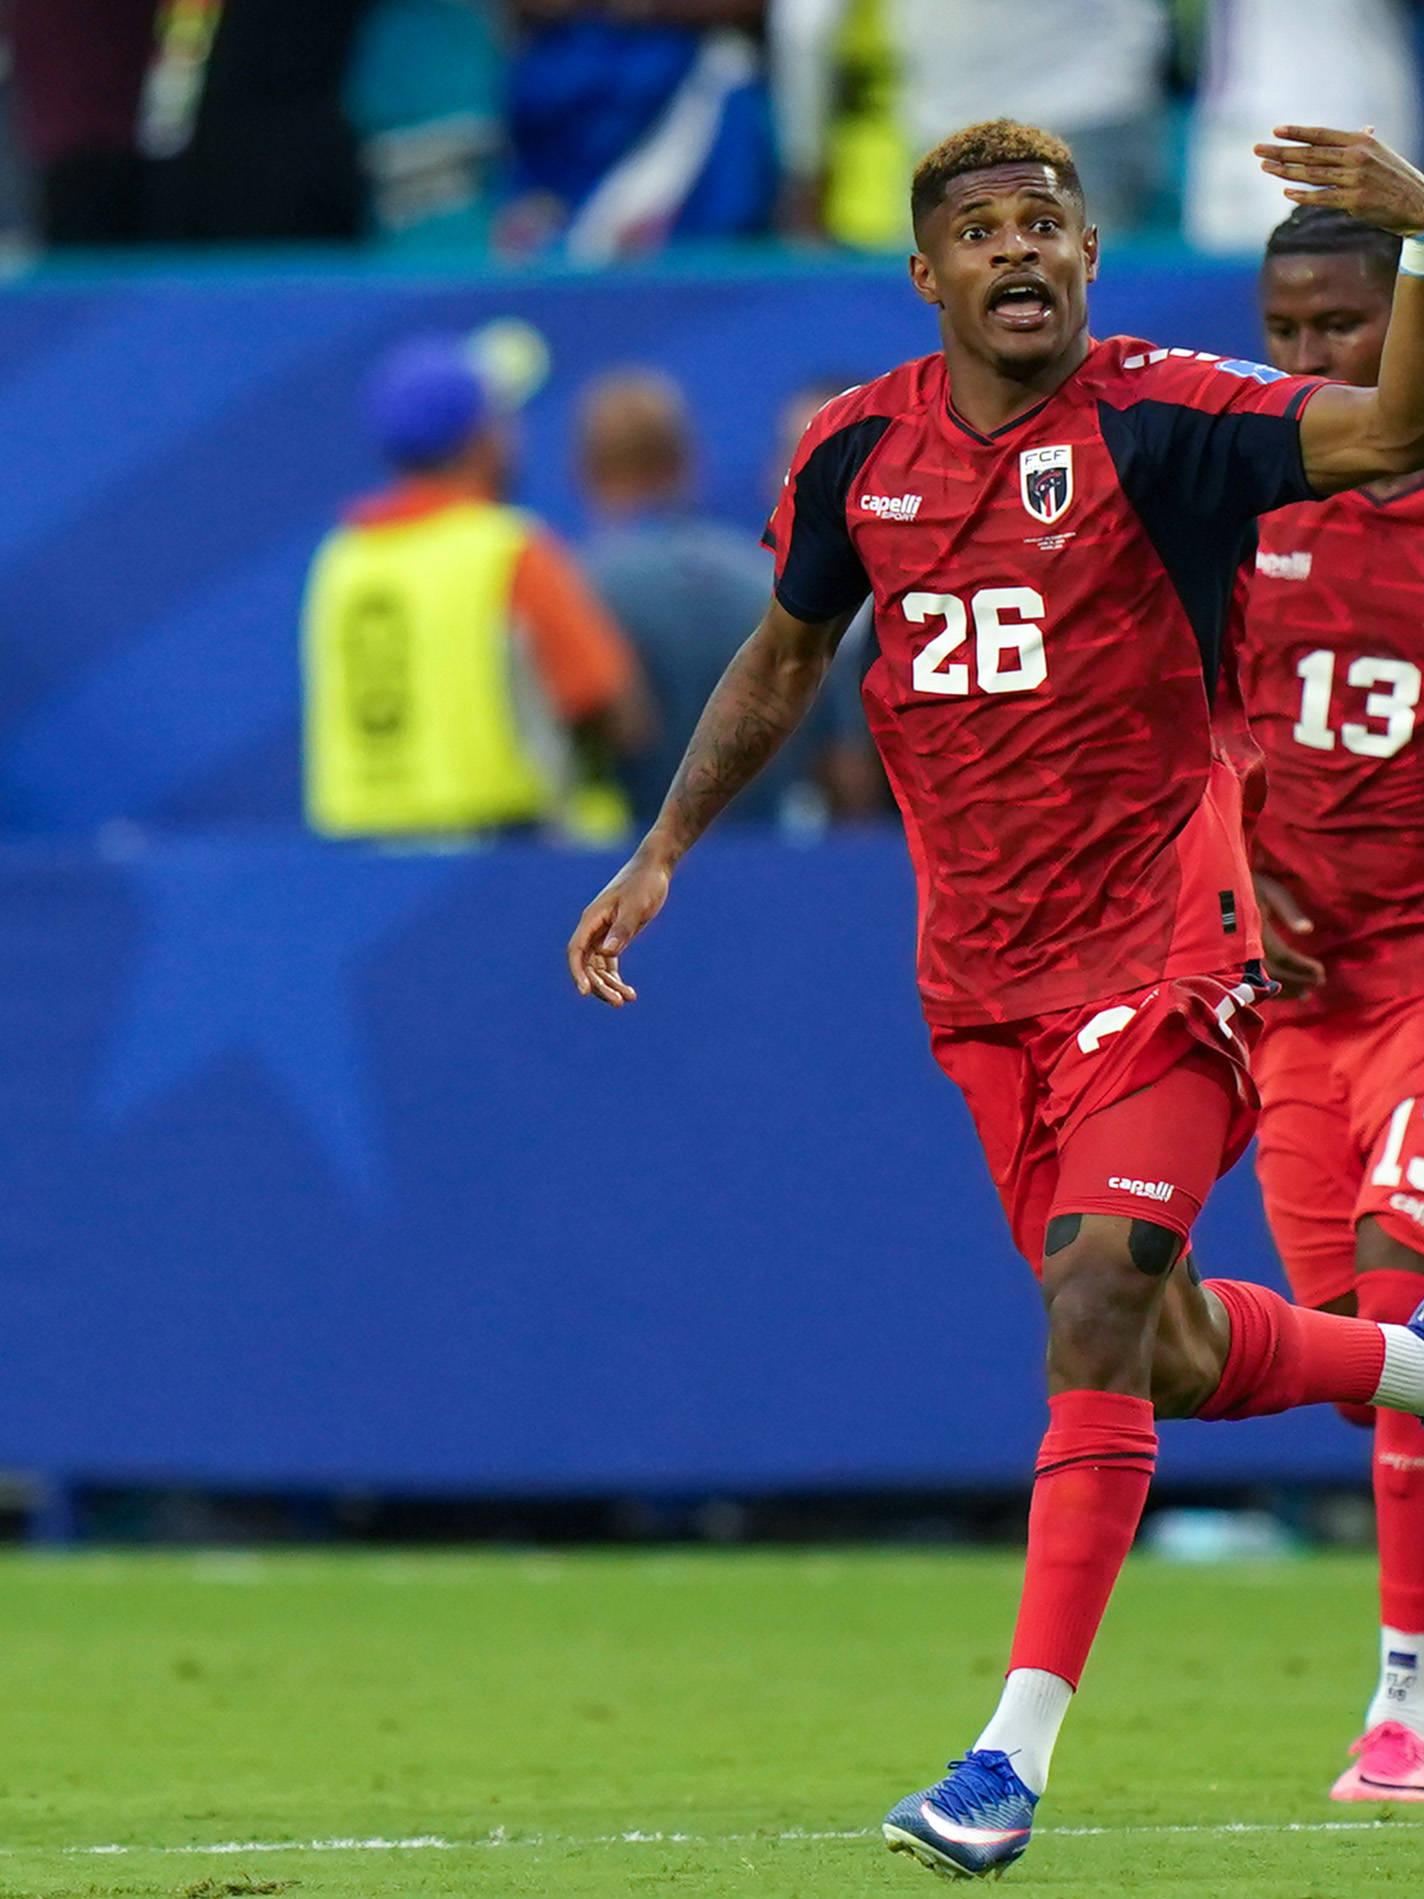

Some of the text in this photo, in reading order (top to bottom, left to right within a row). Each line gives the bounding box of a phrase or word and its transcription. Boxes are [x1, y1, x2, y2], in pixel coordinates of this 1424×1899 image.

[1025, 449, 1067, 465] FCF
[860, 494, 923, 517] capelli
[902, 586, 1048, 695] 26
[1293, 649, 1422, 759] 13
[1108, 1176, 1175, 1201] capelli
